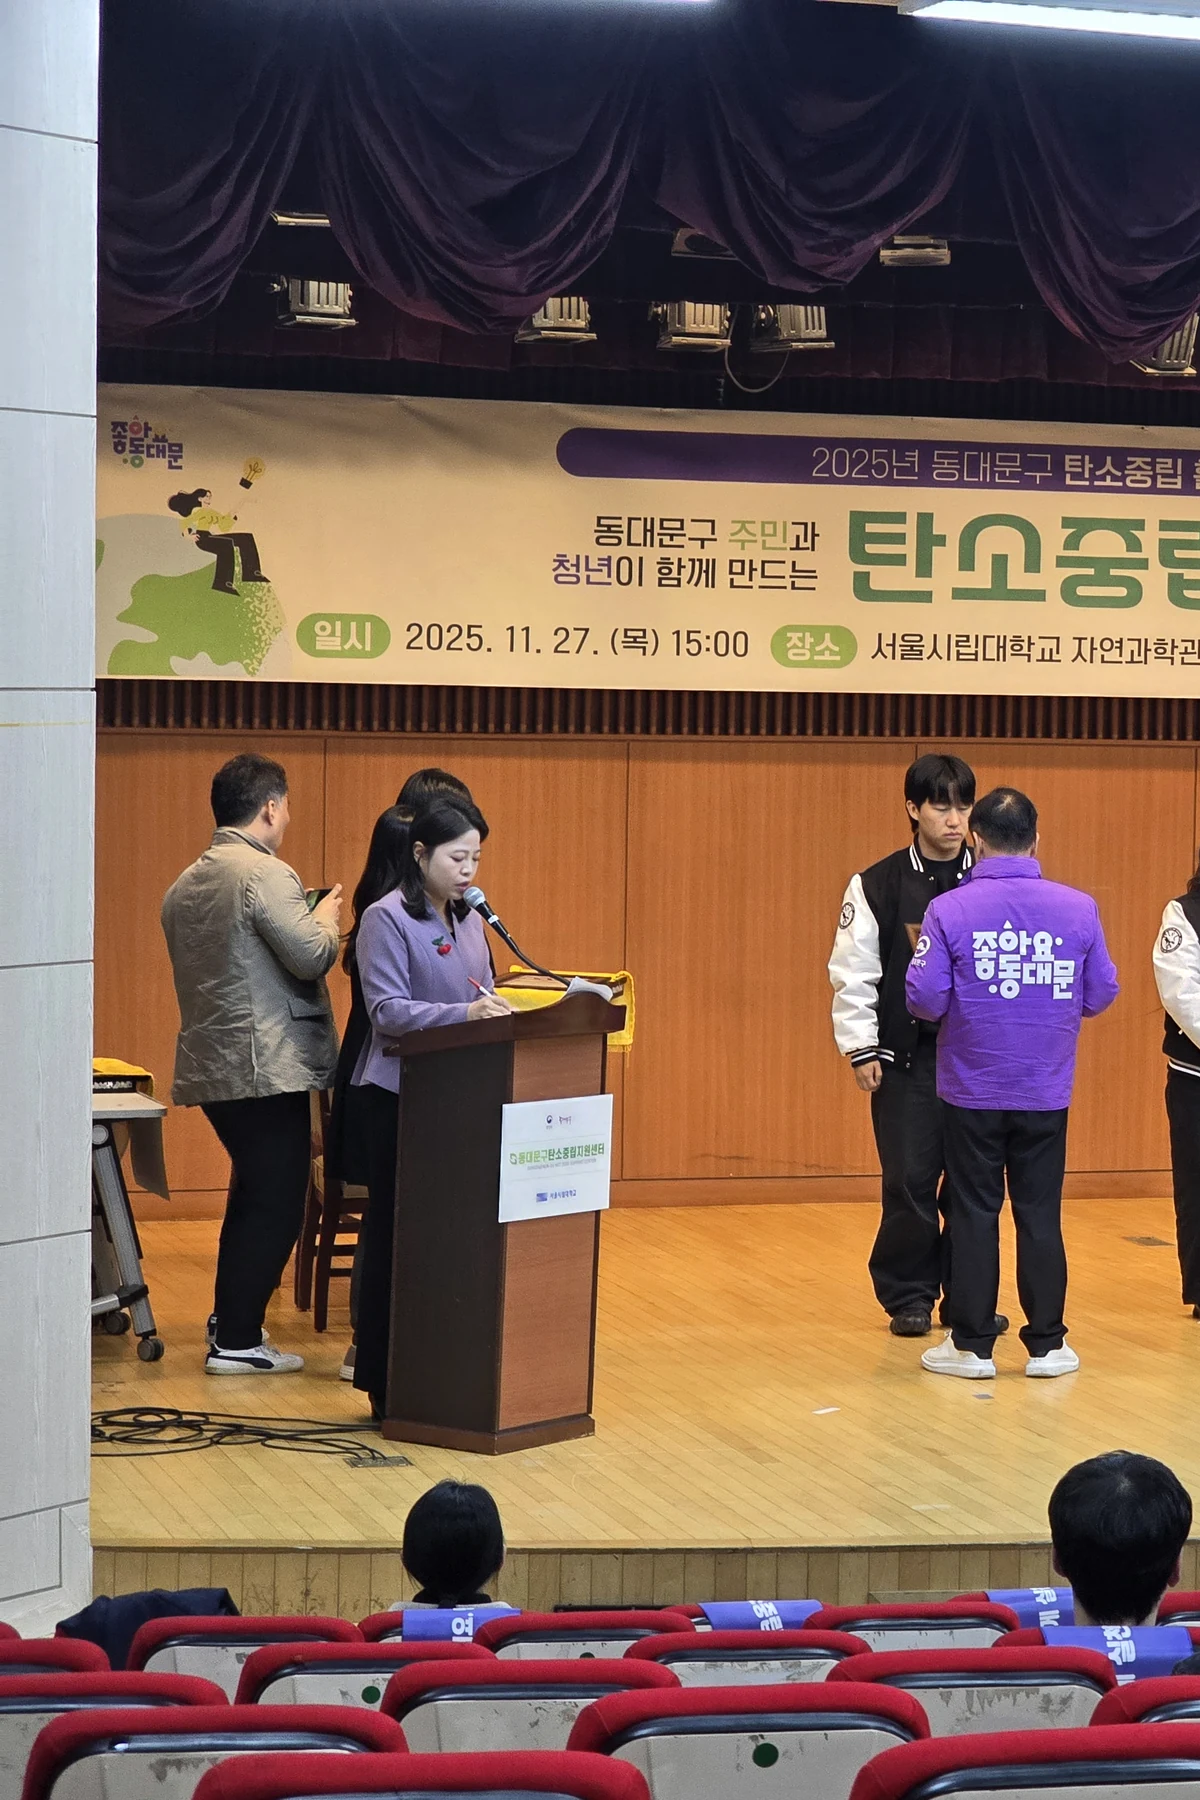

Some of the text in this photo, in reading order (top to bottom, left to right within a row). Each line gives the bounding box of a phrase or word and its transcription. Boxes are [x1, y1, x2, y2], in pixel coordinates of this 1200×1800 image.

[812, 446, 920, 480] 2025년
[931, 450, 1054, 485] 동대문구
[1064, 453, 1184, 490] 탄소중립
[593, 515, 820, 552] 동대문구 주민과
[552, 554, 819, 590] 청년이 함께 만드는
[314, 620, 372, 652] 일시
[405, 622, 750, 659] 2025. 11. 27. (목) 15:00
[785, 633, 840, 662] 장소
[871, 632, 1062, 665] 서울시립대학교
[998, 954, 1075, 1000] 동대문
[518, 1143, 605, 1165] 동대문구탄소중립지원센터
